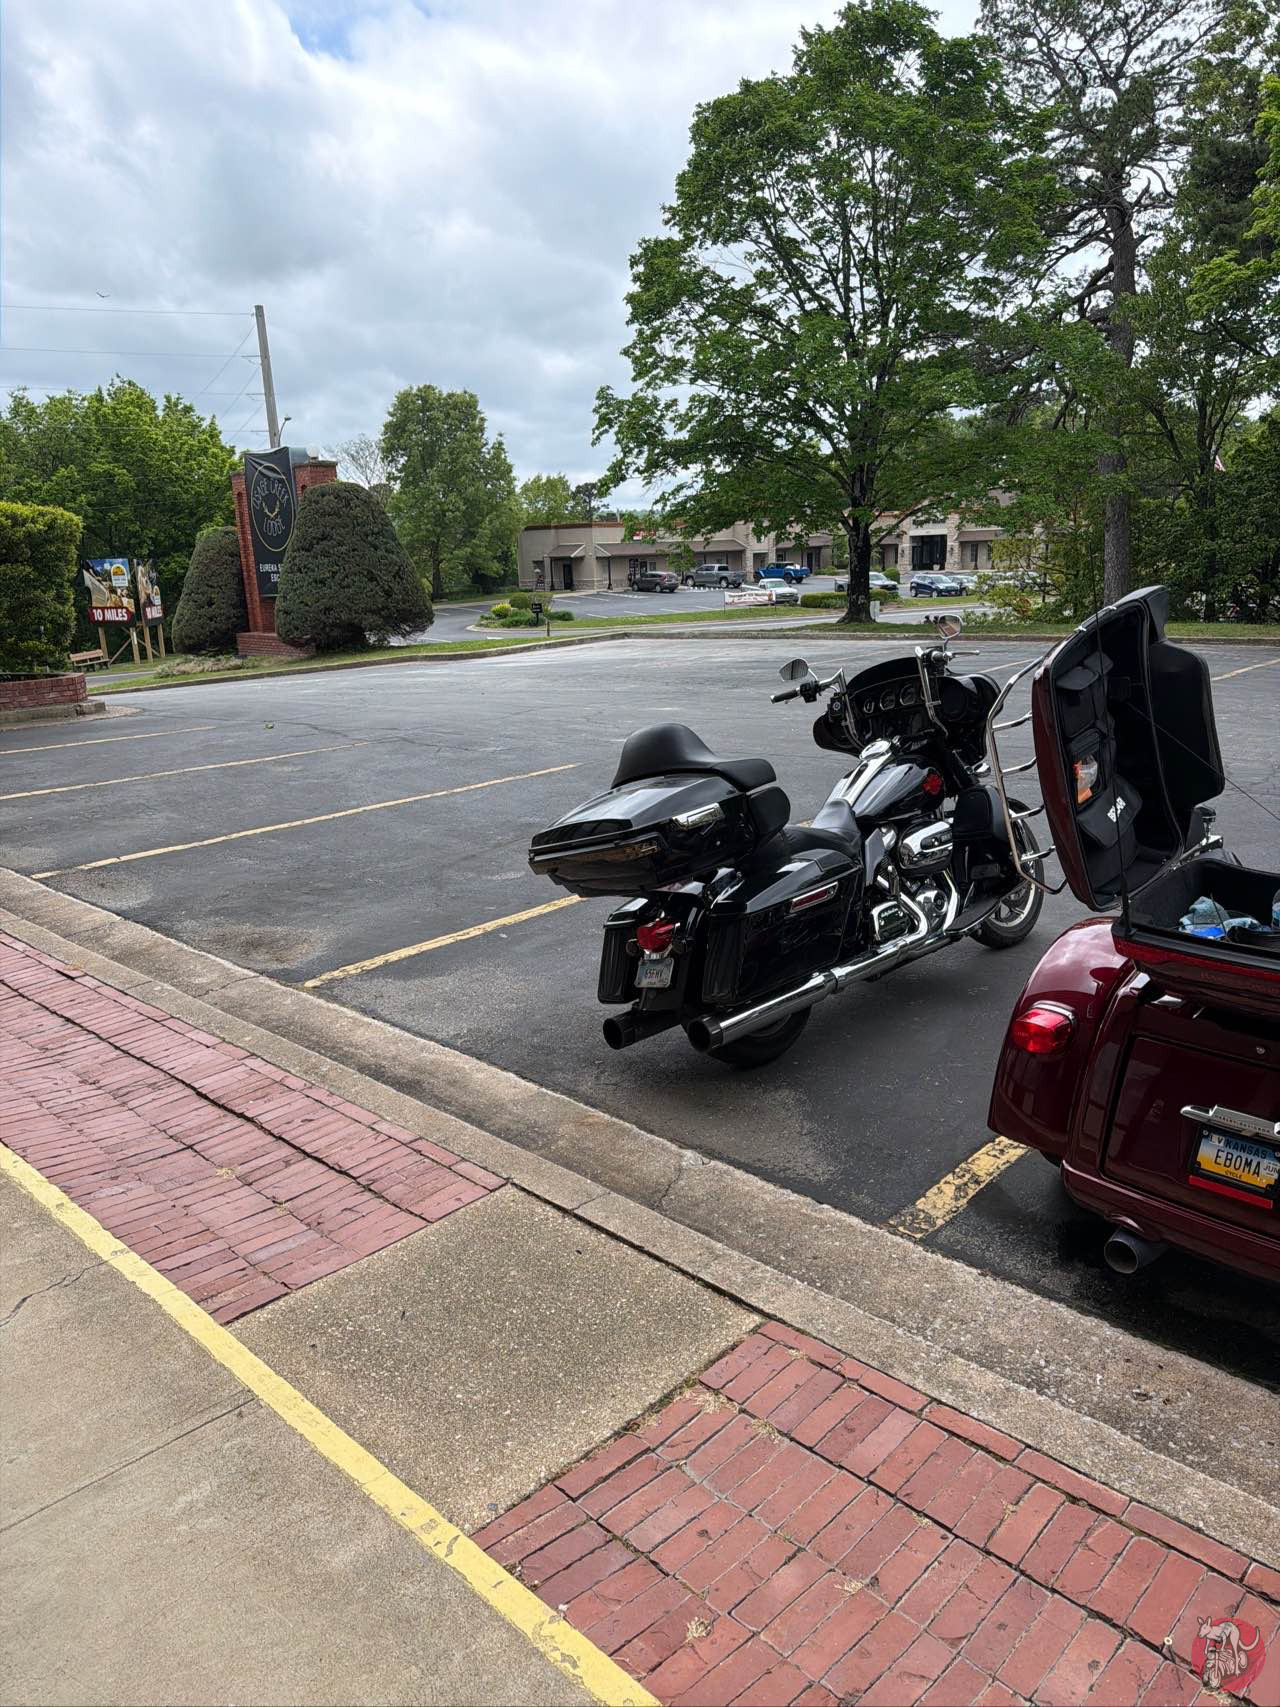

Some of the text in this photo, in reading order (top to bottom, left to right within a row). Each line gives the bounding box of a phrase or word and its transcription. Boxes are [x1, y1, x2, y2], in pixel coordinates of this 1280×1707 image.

[253, 479, 289, 509] OSAGE CREEK
[263, 515, 286, 536] LODGE
[259, 563, 278, 572] EUREKA
[93, 608, 128, 621] 10 MILES
[1225, 1137, 1267, 1159] KANSAS
[1214, 1149, 1261, 1178] EBOMA
[1263, 1165, 1280, 1174] JUN
[1224, 1170, 1243, 1180] CYCLE
